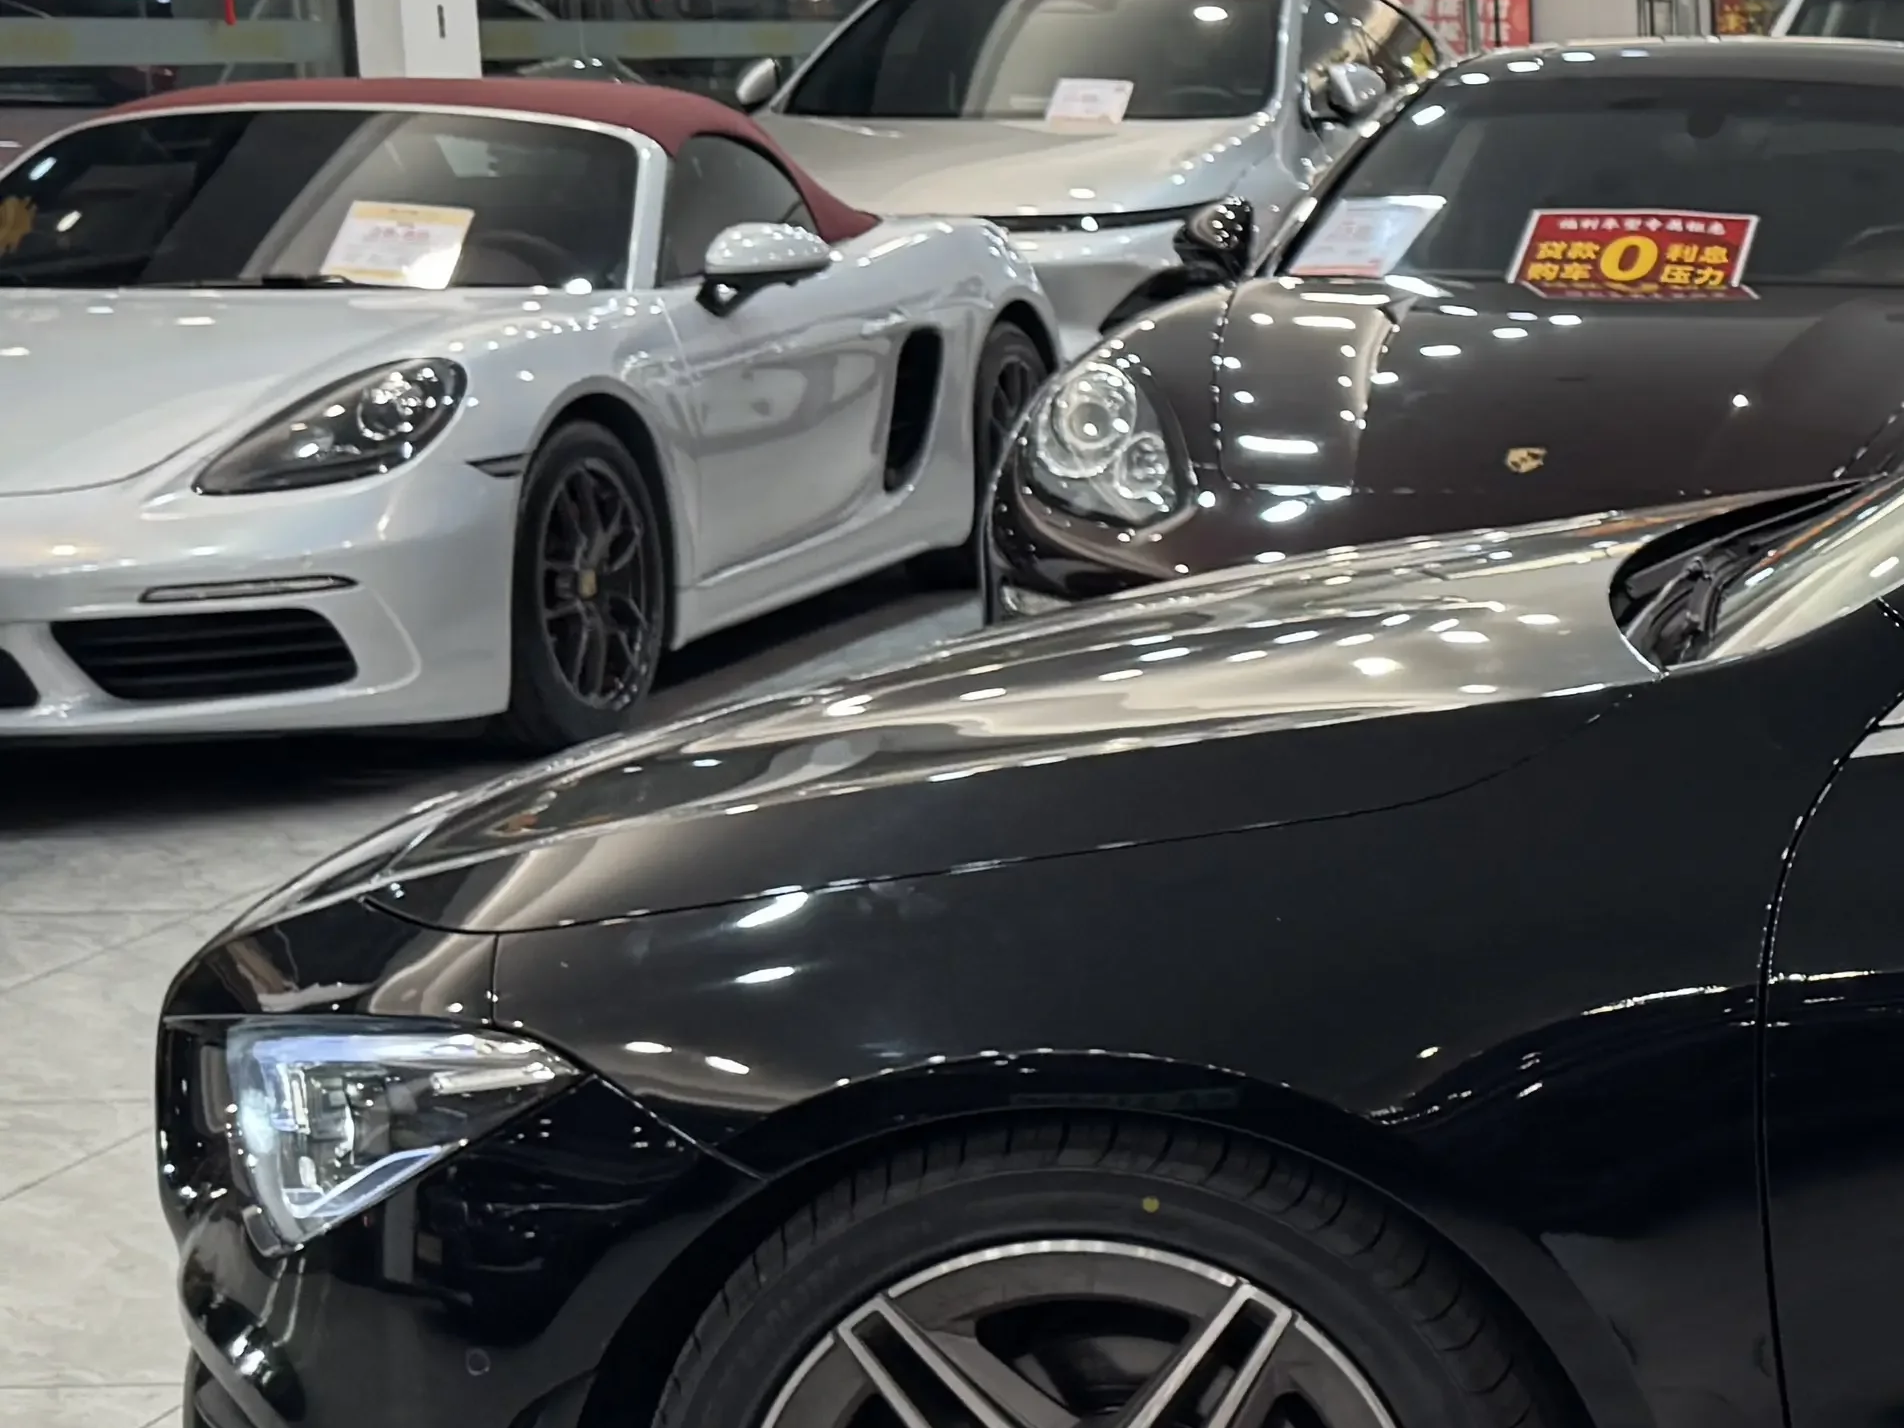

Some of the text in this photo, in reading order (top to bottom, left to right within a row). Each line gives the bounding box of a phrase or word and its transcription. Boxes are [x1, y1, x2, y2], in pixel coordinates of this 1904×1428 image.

[1527, 262, 1725, 285] 购车 压力
[1536, 235, 1729, 282] 贷款 0 利息
